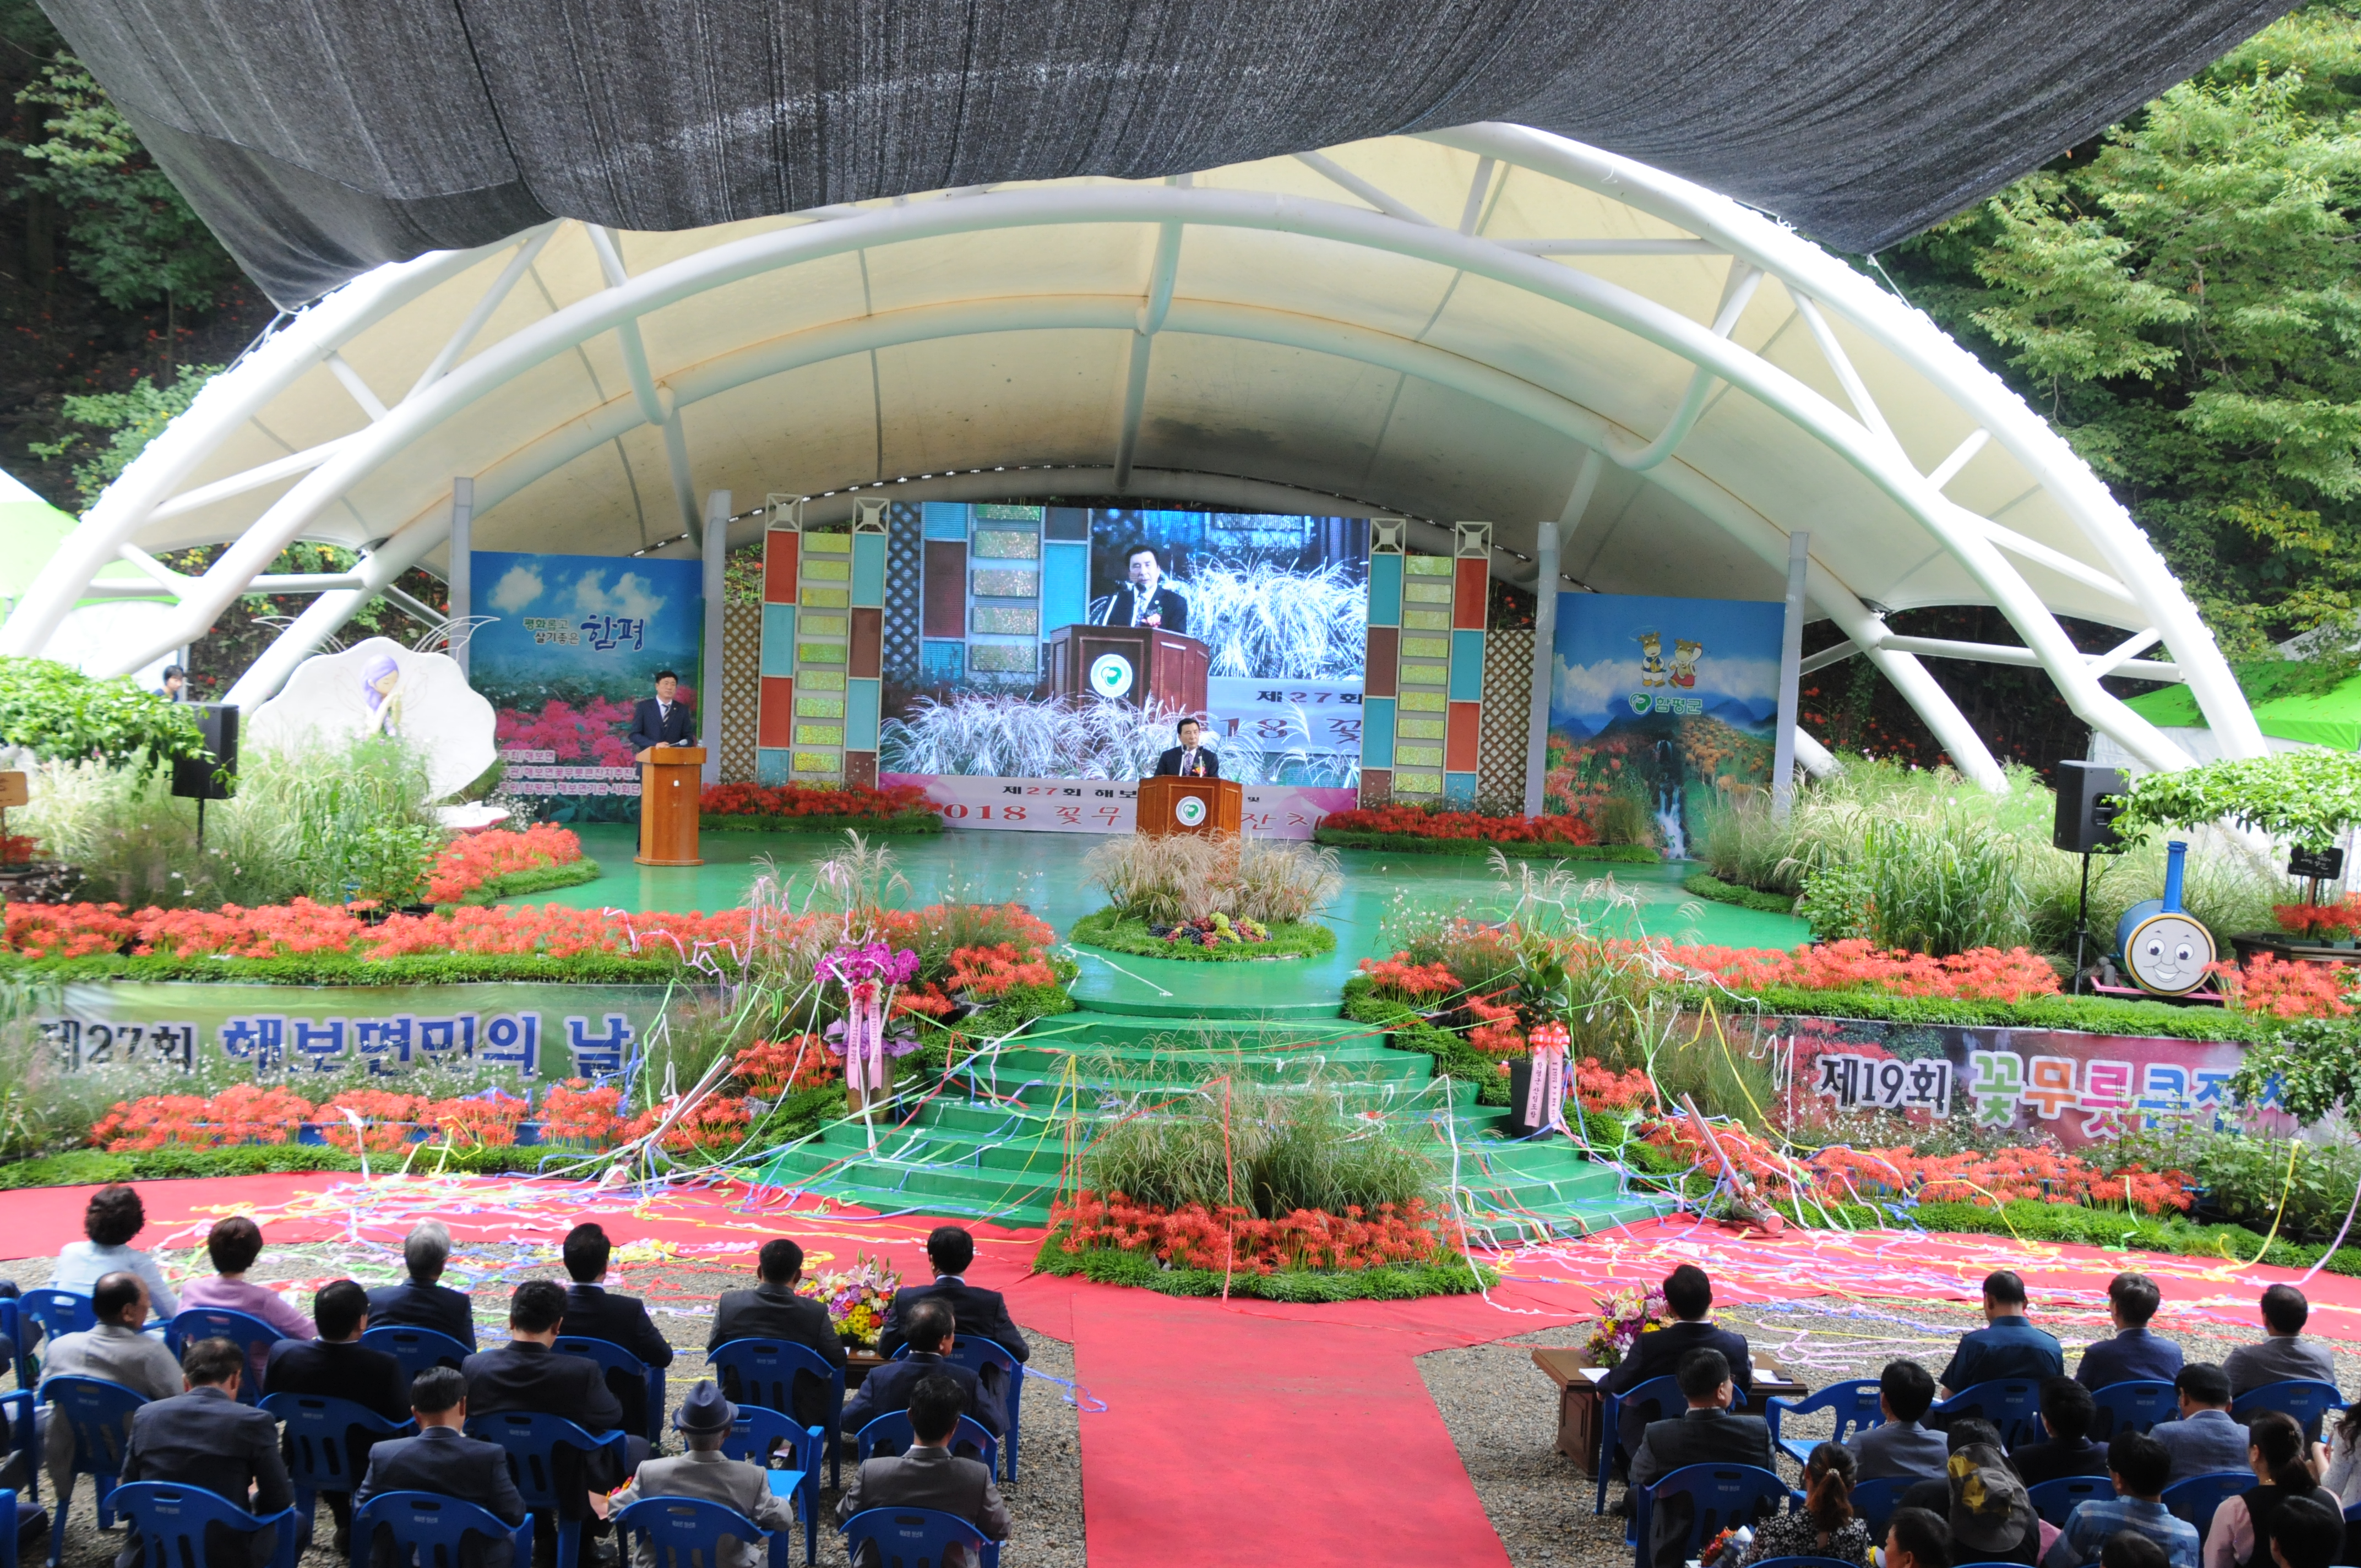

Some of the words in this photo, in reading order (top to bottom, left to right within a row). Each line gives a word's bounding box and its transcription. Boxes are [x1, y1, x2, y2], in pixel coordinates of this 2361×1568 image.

[524, 618, 569, 631] 평화롭고
[580, 614, 644, 651] 함평
[535, 631, 579, 645] 살기좋은
[1256, 690, 1362, 705] 제27회
[1655, 696, 1703, 715] 함평군
[1218, 717, 1288, 739] 18
[1002, 786, 1081, 797] 제27회
[1095, 789, 1138, 799] 해보
[943, 803, 1027, 821] 018
[40, 1020, 192, 1074] 제27회
[222, 1016, 536, 1077] 해보면민의
[568, 1016, 631, 1079] 날
[1820, 1058, 1948, 1114] 제19회
